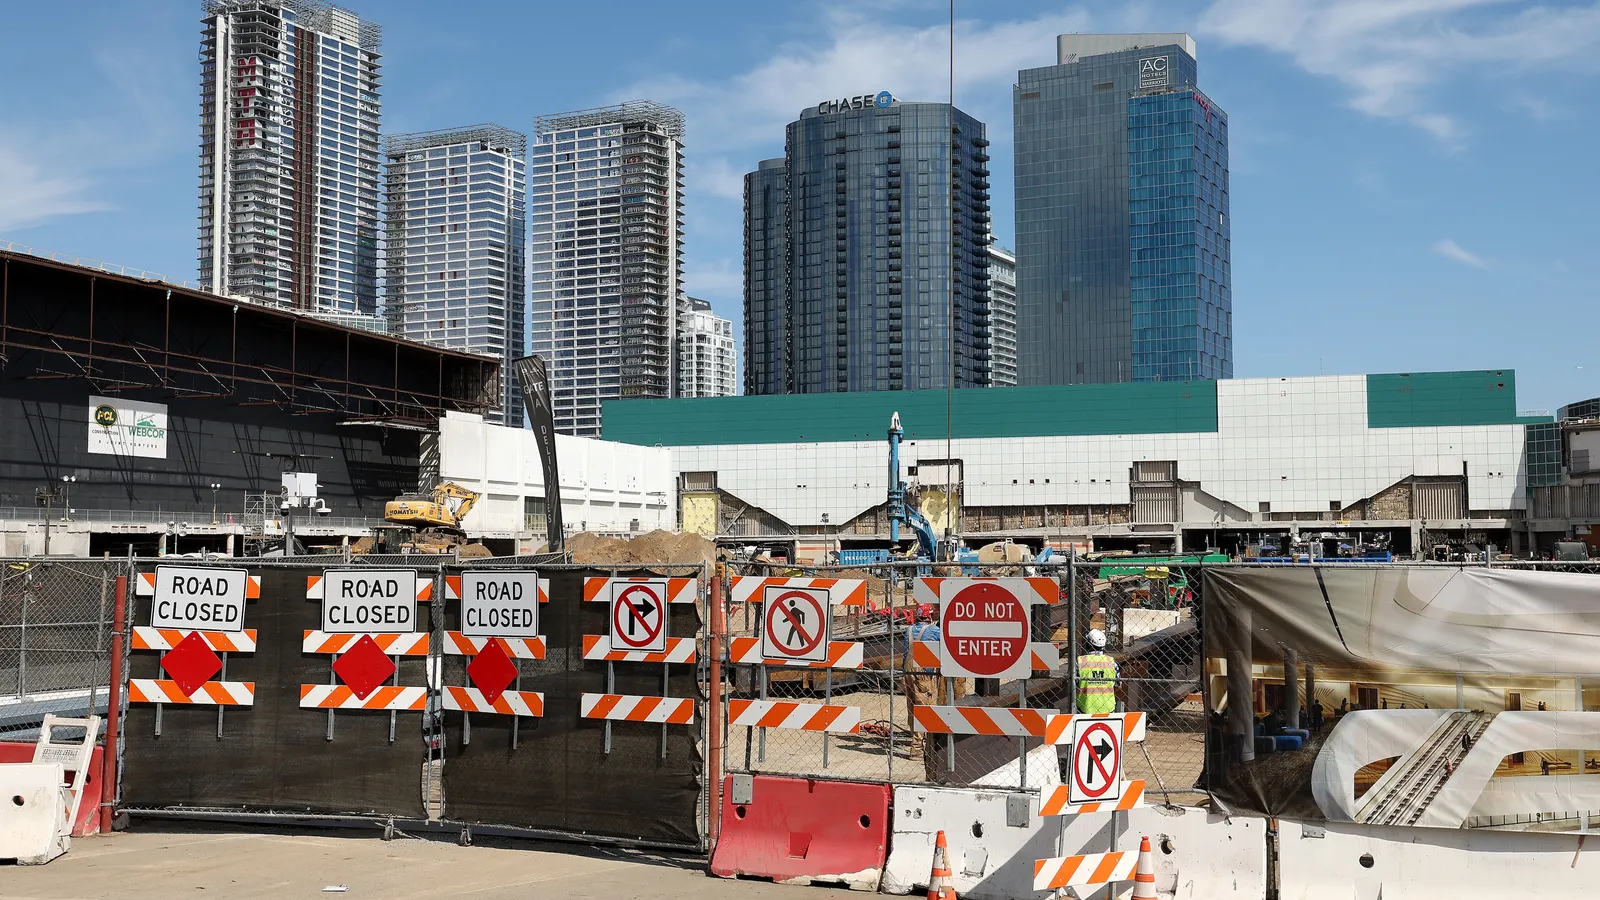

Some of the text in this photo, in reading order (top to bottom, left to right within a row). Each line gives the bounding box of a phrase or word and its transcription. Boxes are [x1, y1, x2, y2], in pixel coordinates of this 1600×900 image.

[1141, 58, 1166, 72] AC
[818, 94, 875, 115] CHASE
[128, 426, 165, 439] WEBCOR
[172, 576, 228, 596] ROAD
[341, 579, 398, 598] ROAD
[476, 581, 523, 600] ROAD
[158, 601, 238, 622] CLOSED
[329, 605, 410, 624] CLOSED
[466, 608, 533, 627] CLOSED
[955, 602, 1014, 618] DO NOT
[958, 639, 1012, 656] ENTER
